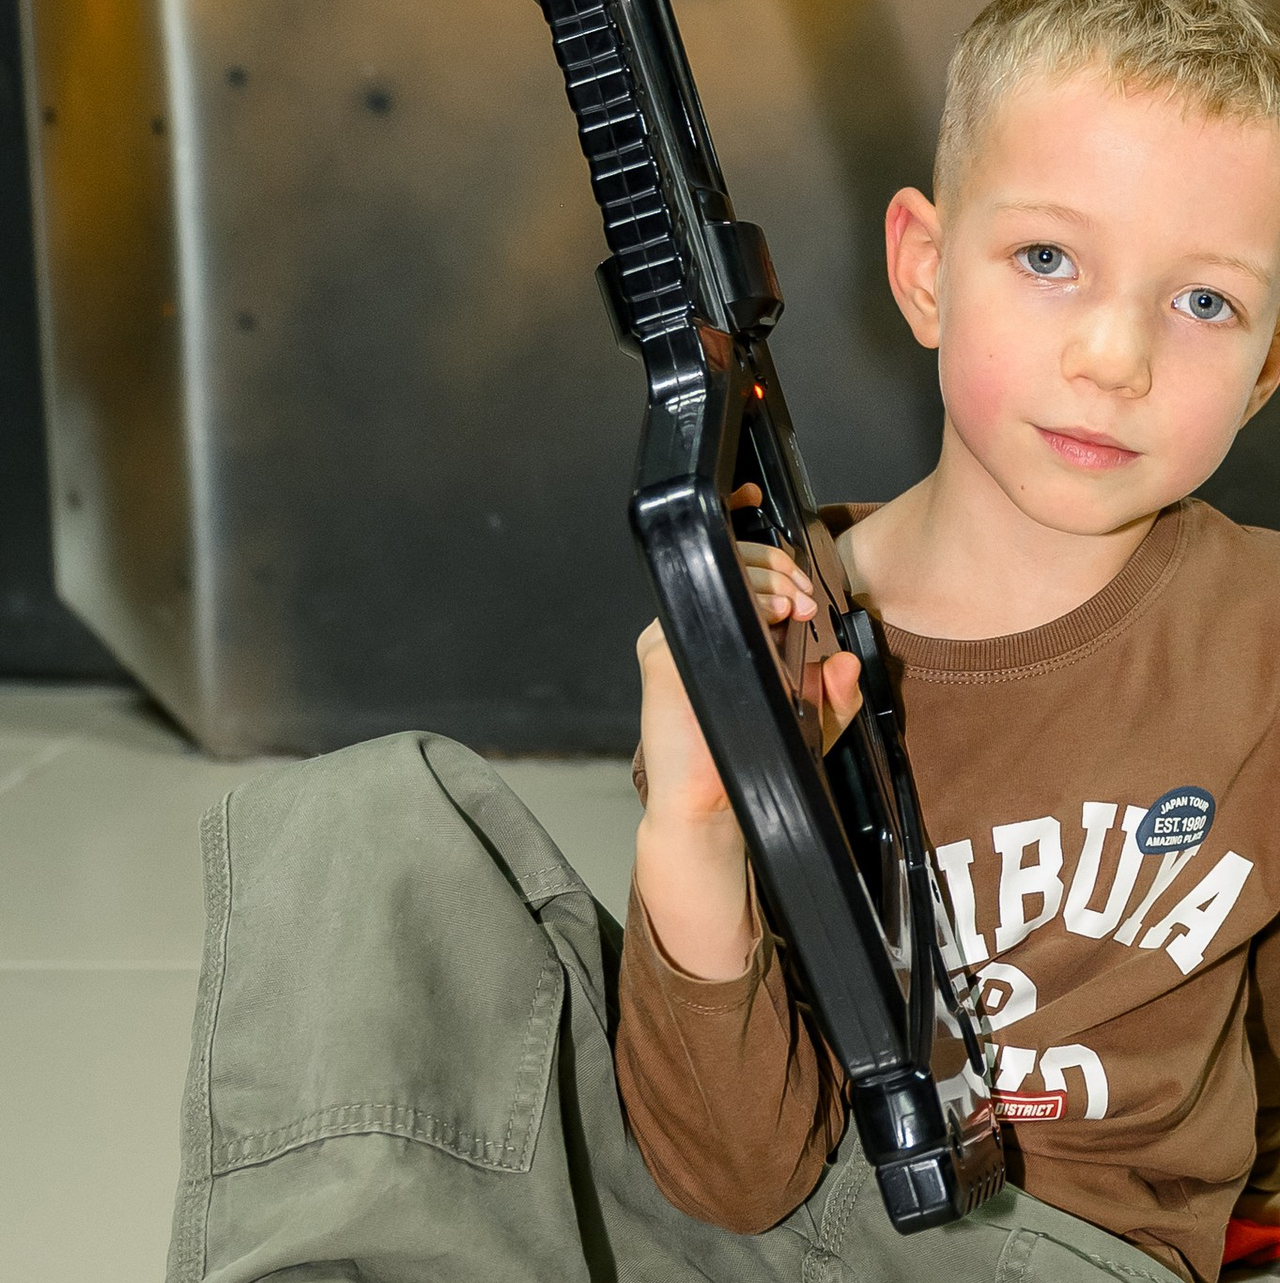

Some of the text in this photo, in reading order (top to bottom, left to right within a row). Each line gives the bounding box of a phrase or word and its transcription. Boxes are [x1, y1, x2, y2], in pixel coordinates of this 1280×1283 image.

[1160, 796, 1210, 815] JAPAN TOUR
[1145, 834, 1183, 847] AMAZING
[935, 801, 1254, 976] IBUYA
[994, 1102, 1055, 1117] DISTRICT
